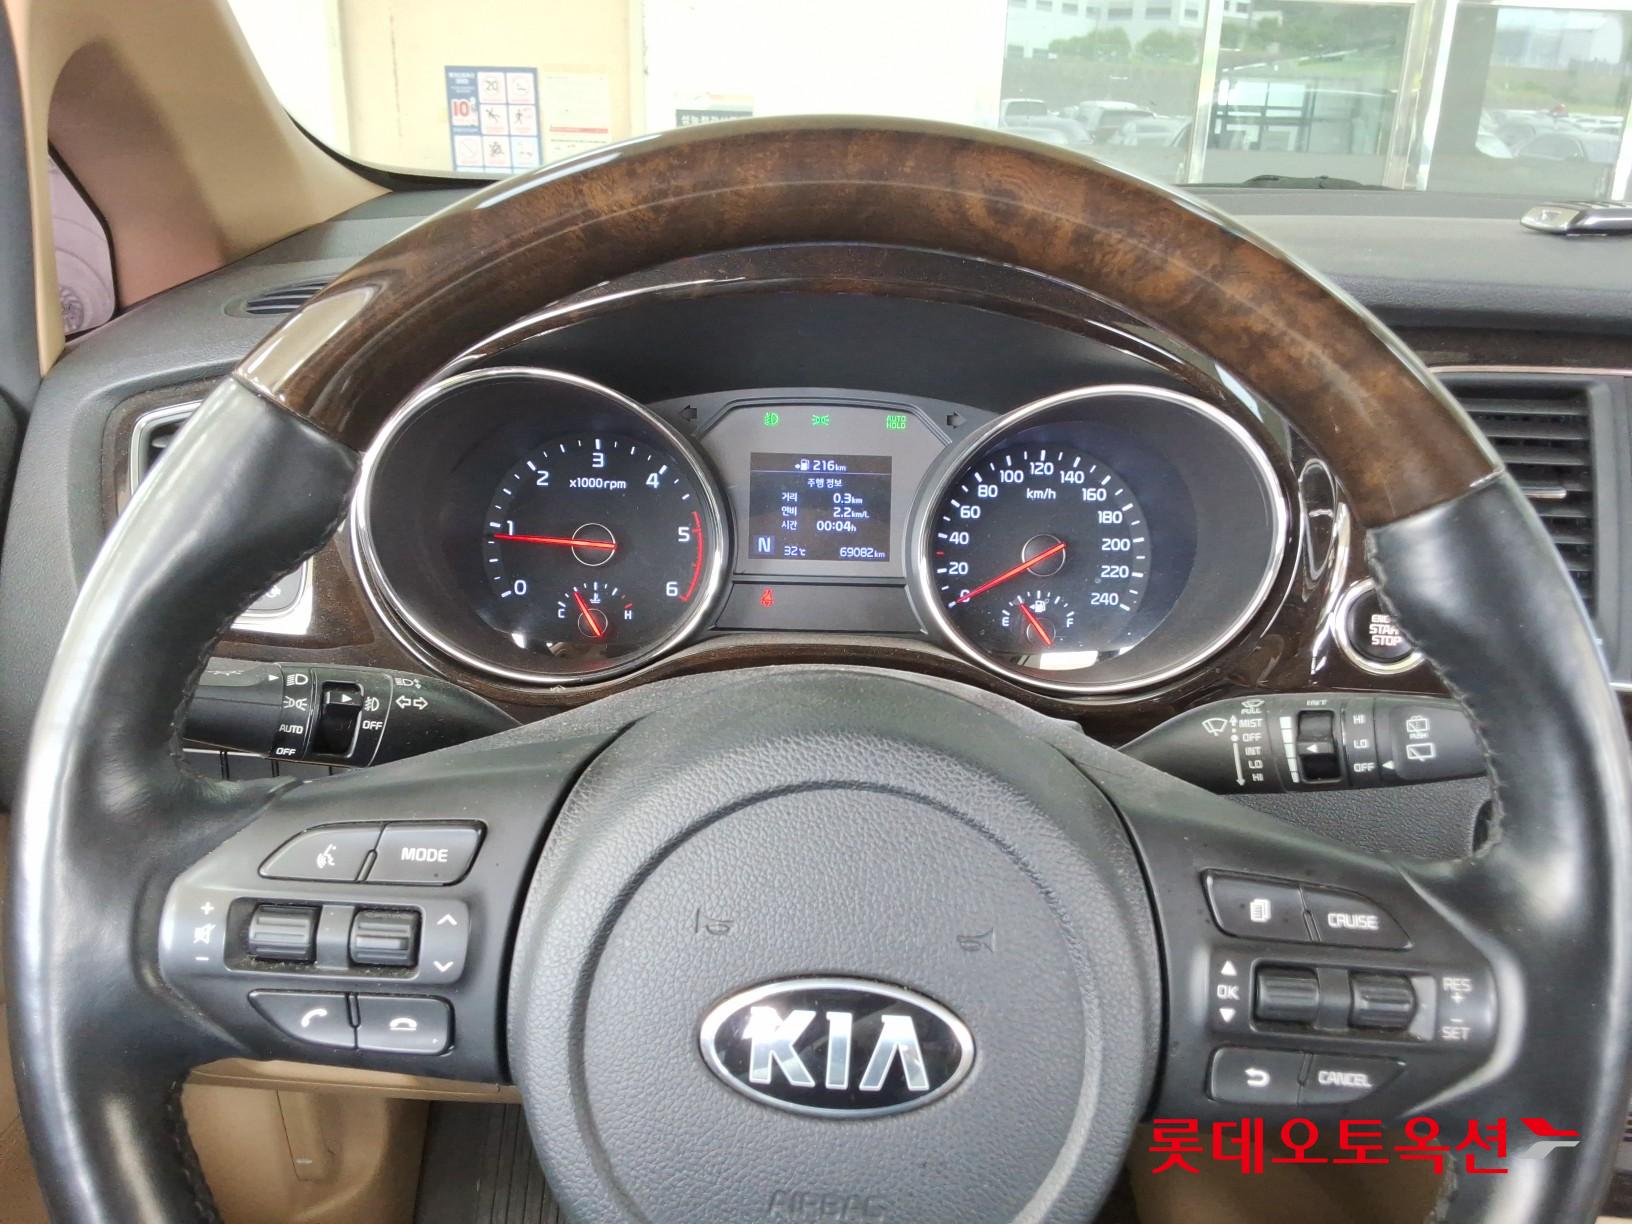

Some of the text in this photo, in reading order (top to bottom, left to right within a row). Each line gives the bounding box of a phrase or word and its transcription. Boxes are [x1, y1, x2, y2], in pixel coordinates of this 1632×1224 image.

[592, 452, 604, 468] 3
[1030, 462, 1054, 475] 120
[536, 470, 549, 486] 2
[646, 473, 659, 488] 4
[1000, 470, 1024, 483] 100
[1060, 471, 1085, 484] 140
[781, 492, 798, 502] 거리
[977, 485, 998, 498] 80
[1026, 488, 1056, 500] km/h
[1082, 488, 1107, 501] 160
[960, 506, 981, 519] 60
[1098, 511, 1123, 524] 180
[506, 520, 514, 535] 1
[781, 520, 798, 531] 시간
[678, 527, 690, 542] 5
[949, 532, 969, 545] 40
[758, 537, 771, 553] N
[1101, 538, 1130, 551] 200
[949, 562, 969, 575] 20
[1101, 565, 1129, 578] 220
[514, 580, 527, 595] 0
[666, 581, 679, 596] 6
[960, 589, 971, 603] 0
[1091, 593, 1119, 606] 240
[558, 608, 566, 619] C
[624, 610, 633, 620] H
[1002, 617, 1010, 627] E
[1066, 618, 1074, 628] F
[1369, 623, 1399, 636] STAR
[1371, 635, 1402, 647] STOP
[362, 720, 383, 731] OFF
[1239, 719, 1263, 728] MIST
[1353, 714, 1365, 724] HI
[279, 723, 303, 735] AUTO
[1242, 733, 1262, 742] OFF
[1354, 739, 1368, 749] LO
[275, 747, 296, 756] OFF
[1248, 760, 1264, 769] LO
[1354, 762, 1375, 773] OFF
[1252, 773, 1264, 782] HI
[401, 847, 448, 863] MODE
[1327, 913, 1379, 930] CRUISE
[1442, 978, 1472, 992] RES
[1217, 985, 1239, 1000] OK
[1441, 1027, 1470, 1040] SET
[743, 1006, 930, 1091] KIA
[1318, 1070, 1373, 1087] CANCEL
